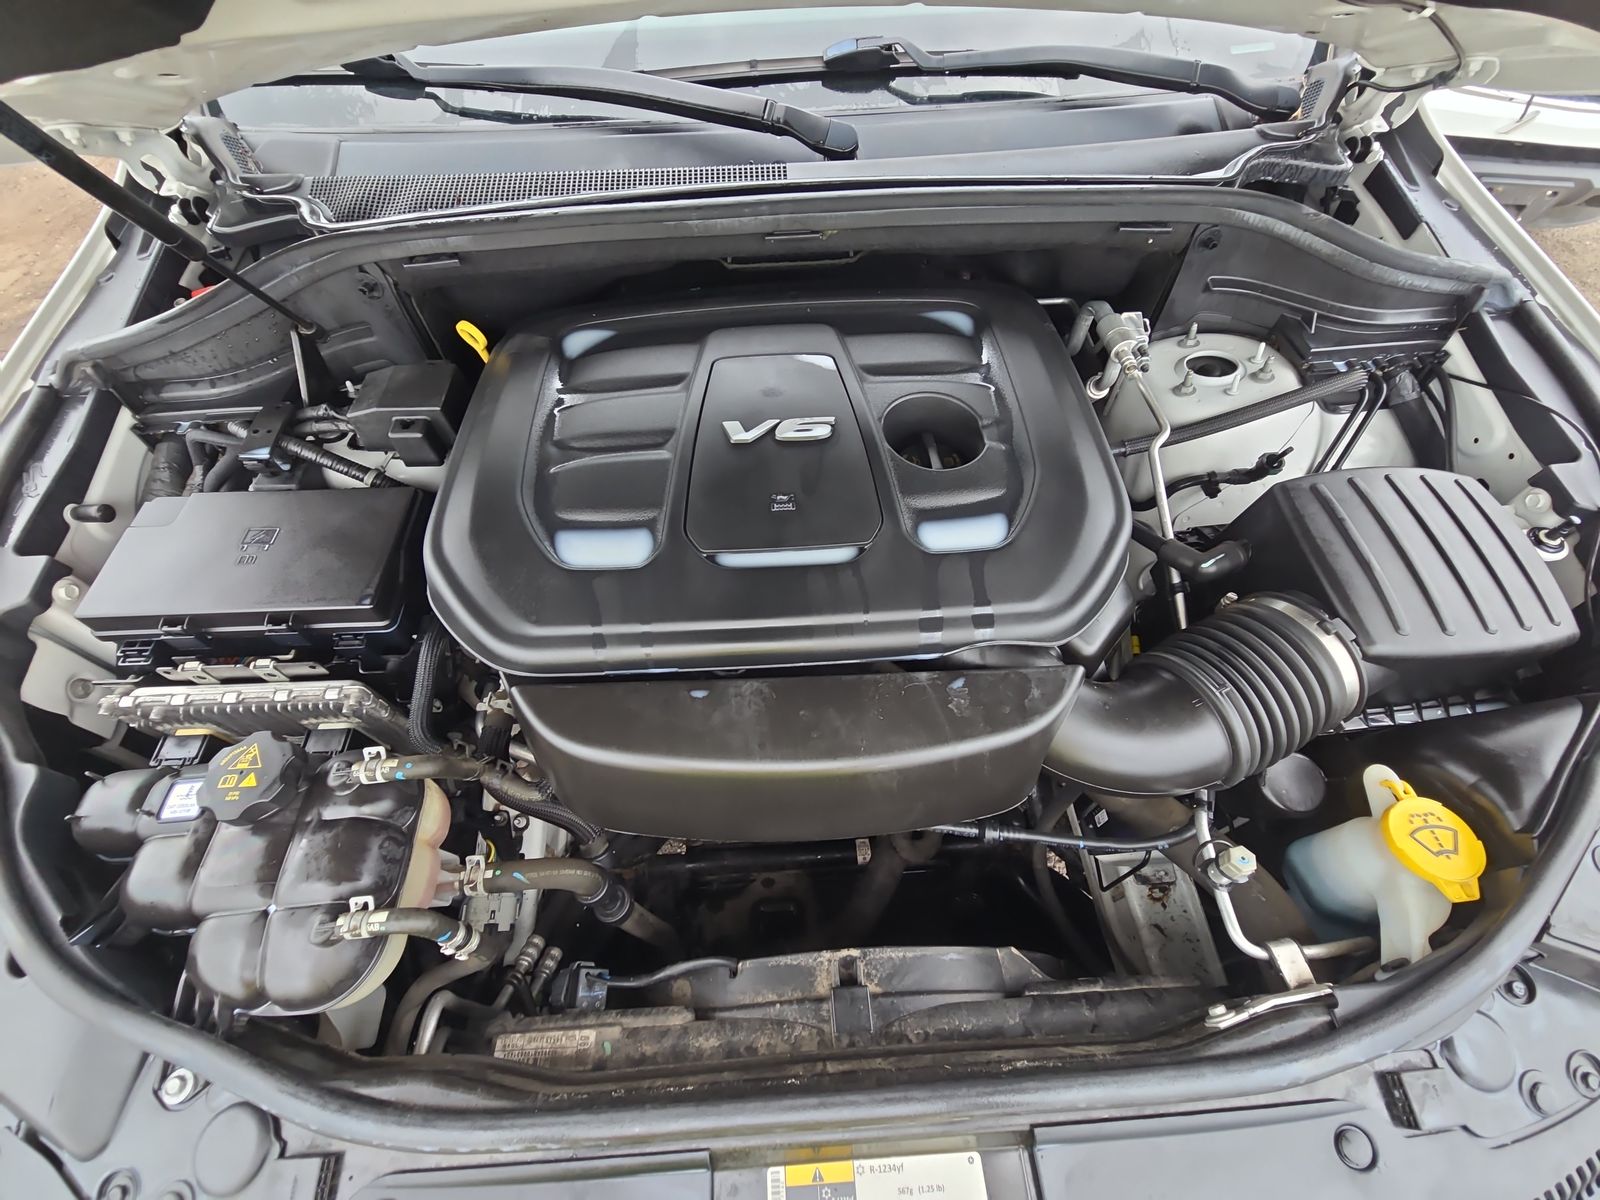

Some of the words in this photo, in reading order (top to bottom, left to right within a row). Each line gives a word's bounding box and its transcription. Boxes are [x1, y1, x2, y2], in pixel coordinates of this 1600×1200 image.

[722, 416, 836, 443] V6
[869, 1162, 904, 1174] R-1234yf
[897, 1187, 914, 1196] 567g
